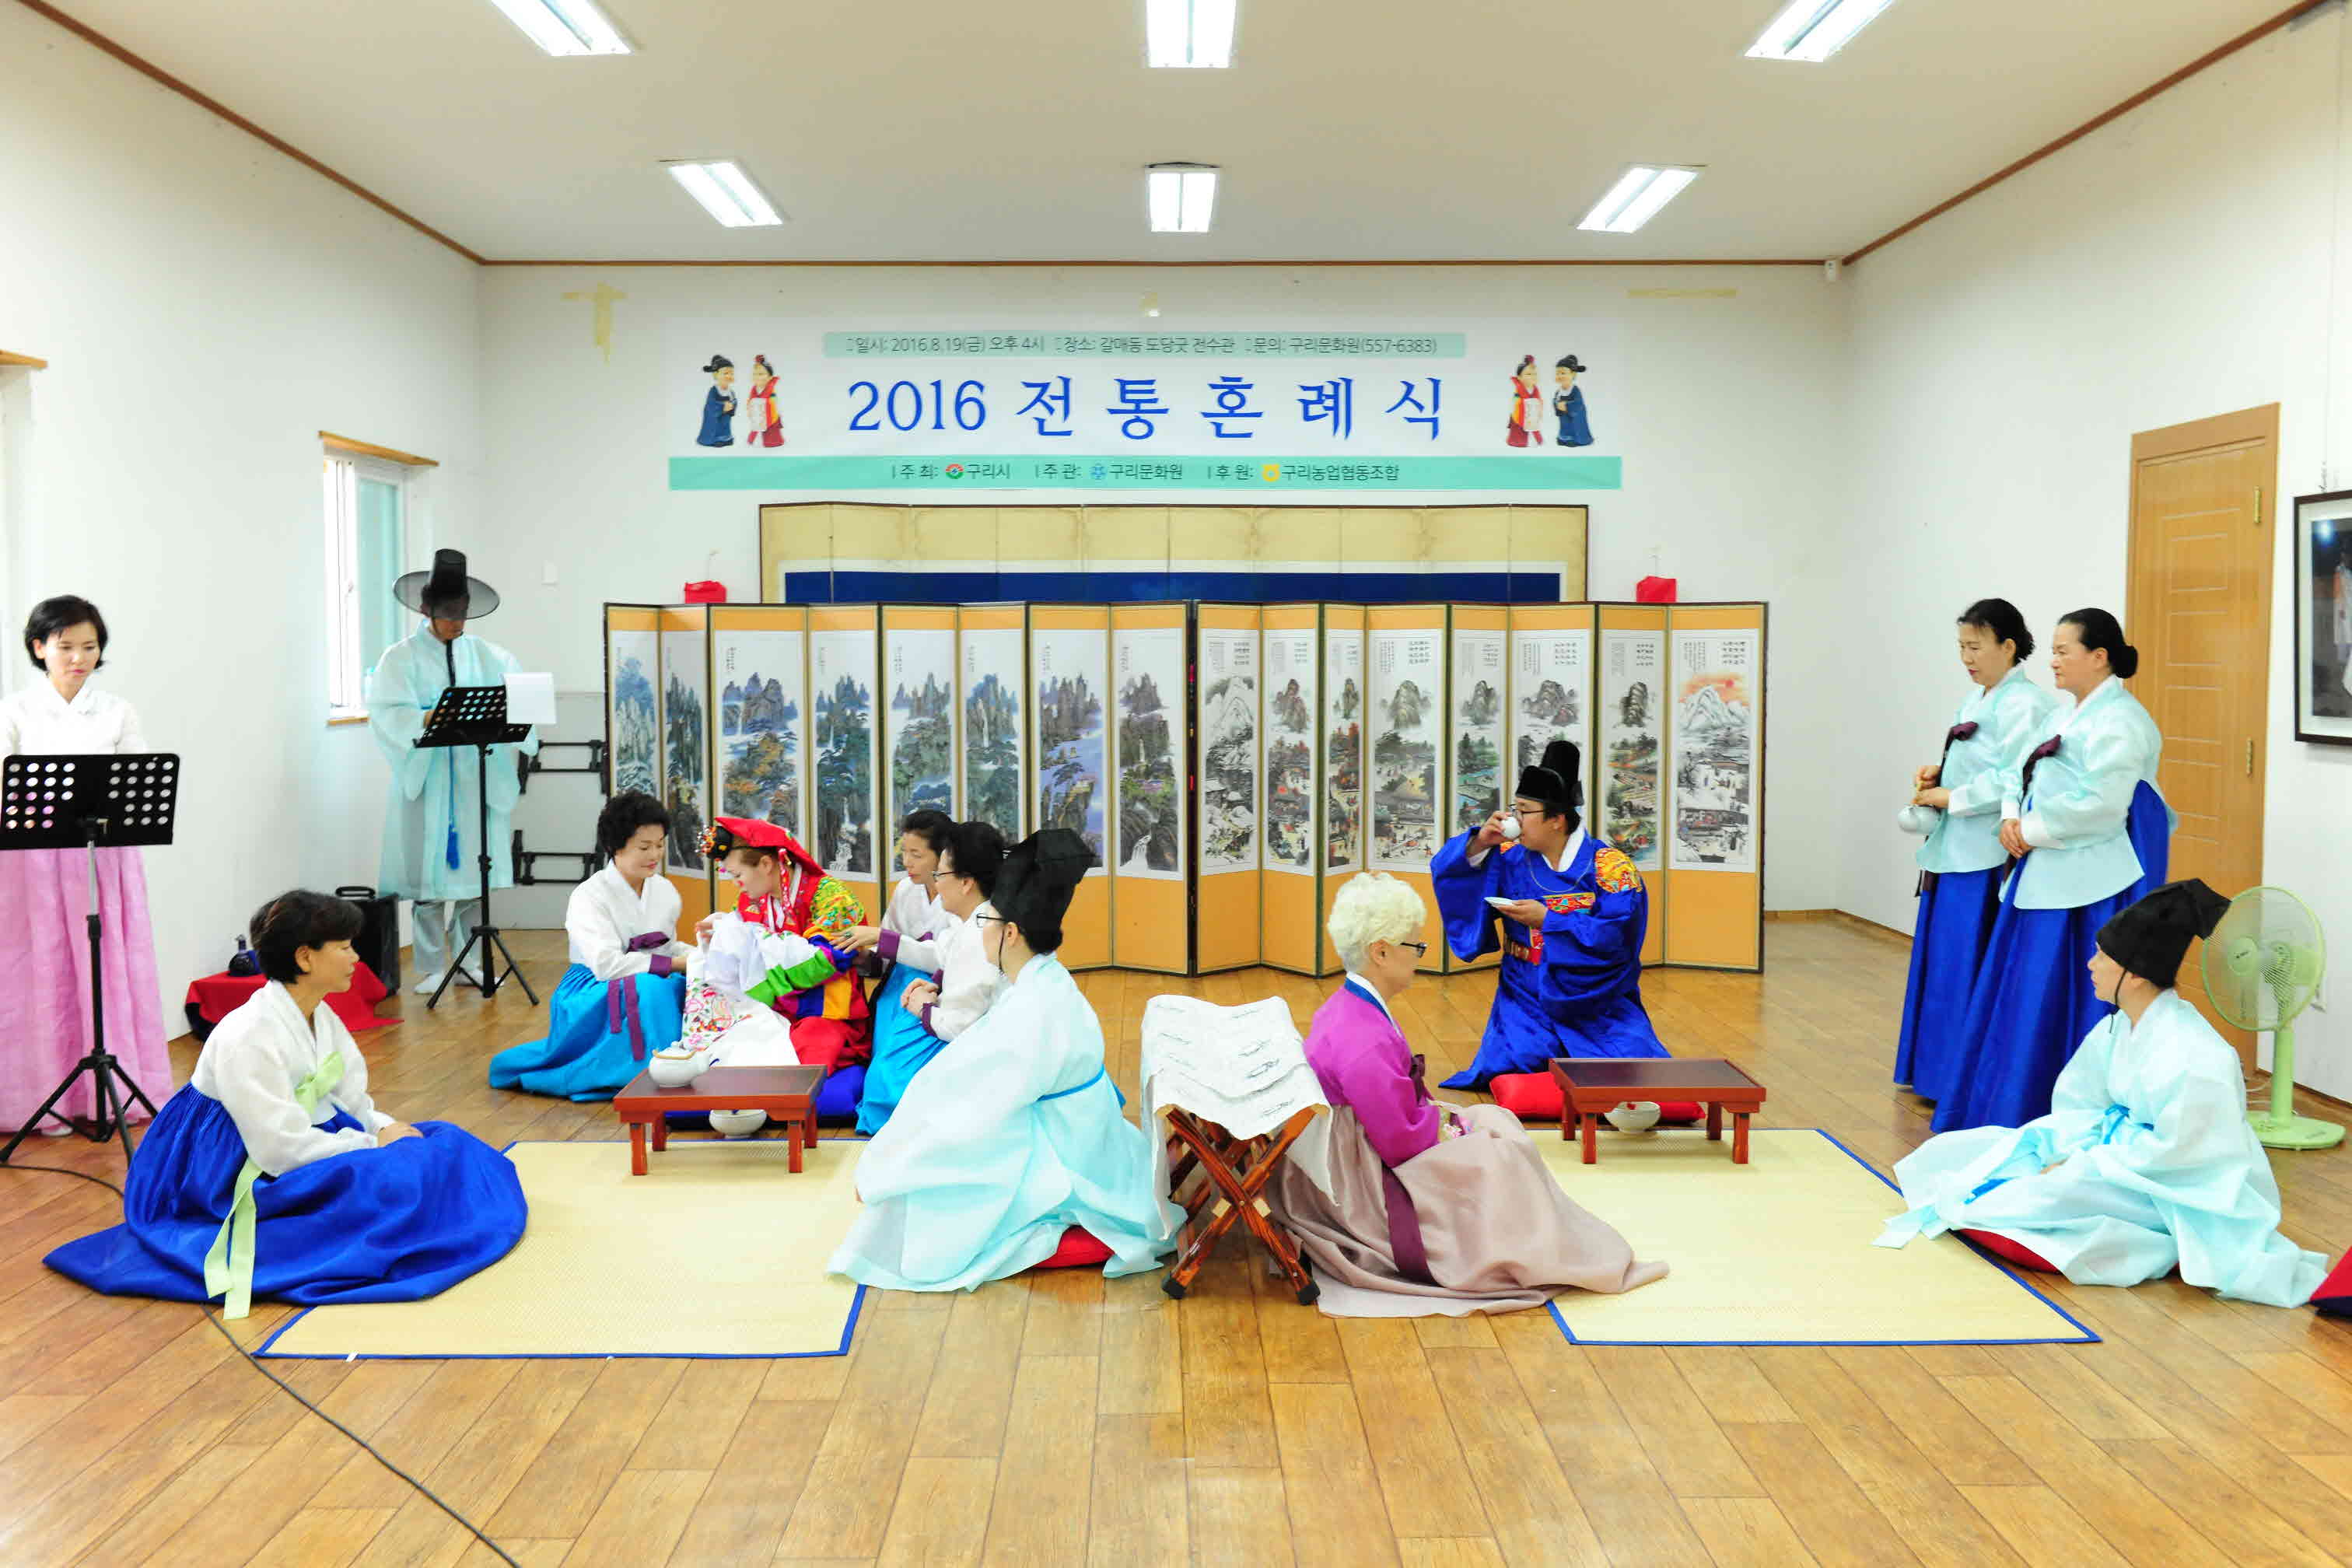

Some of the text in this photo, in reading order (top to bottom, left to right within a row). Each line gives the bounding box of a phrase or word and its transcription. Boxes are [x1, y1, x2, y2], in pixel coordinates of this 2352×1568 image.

[989, 335, 1018, 352] 오후
[1021, 336, 1044, 352] 4시
[1101, 335, 1143, 354] 갈매동
[1144, 335, 1189, 354] 도당굿
[1193, 335, 1237, 355] 전수관
[848, 380, 986, 431] 2016
[965, 463, 1010, 480] 구리시
[1109, 462, 1183, 481] 구리문화원
[1281, 464, 1400, 482] 구리농업협동조합
